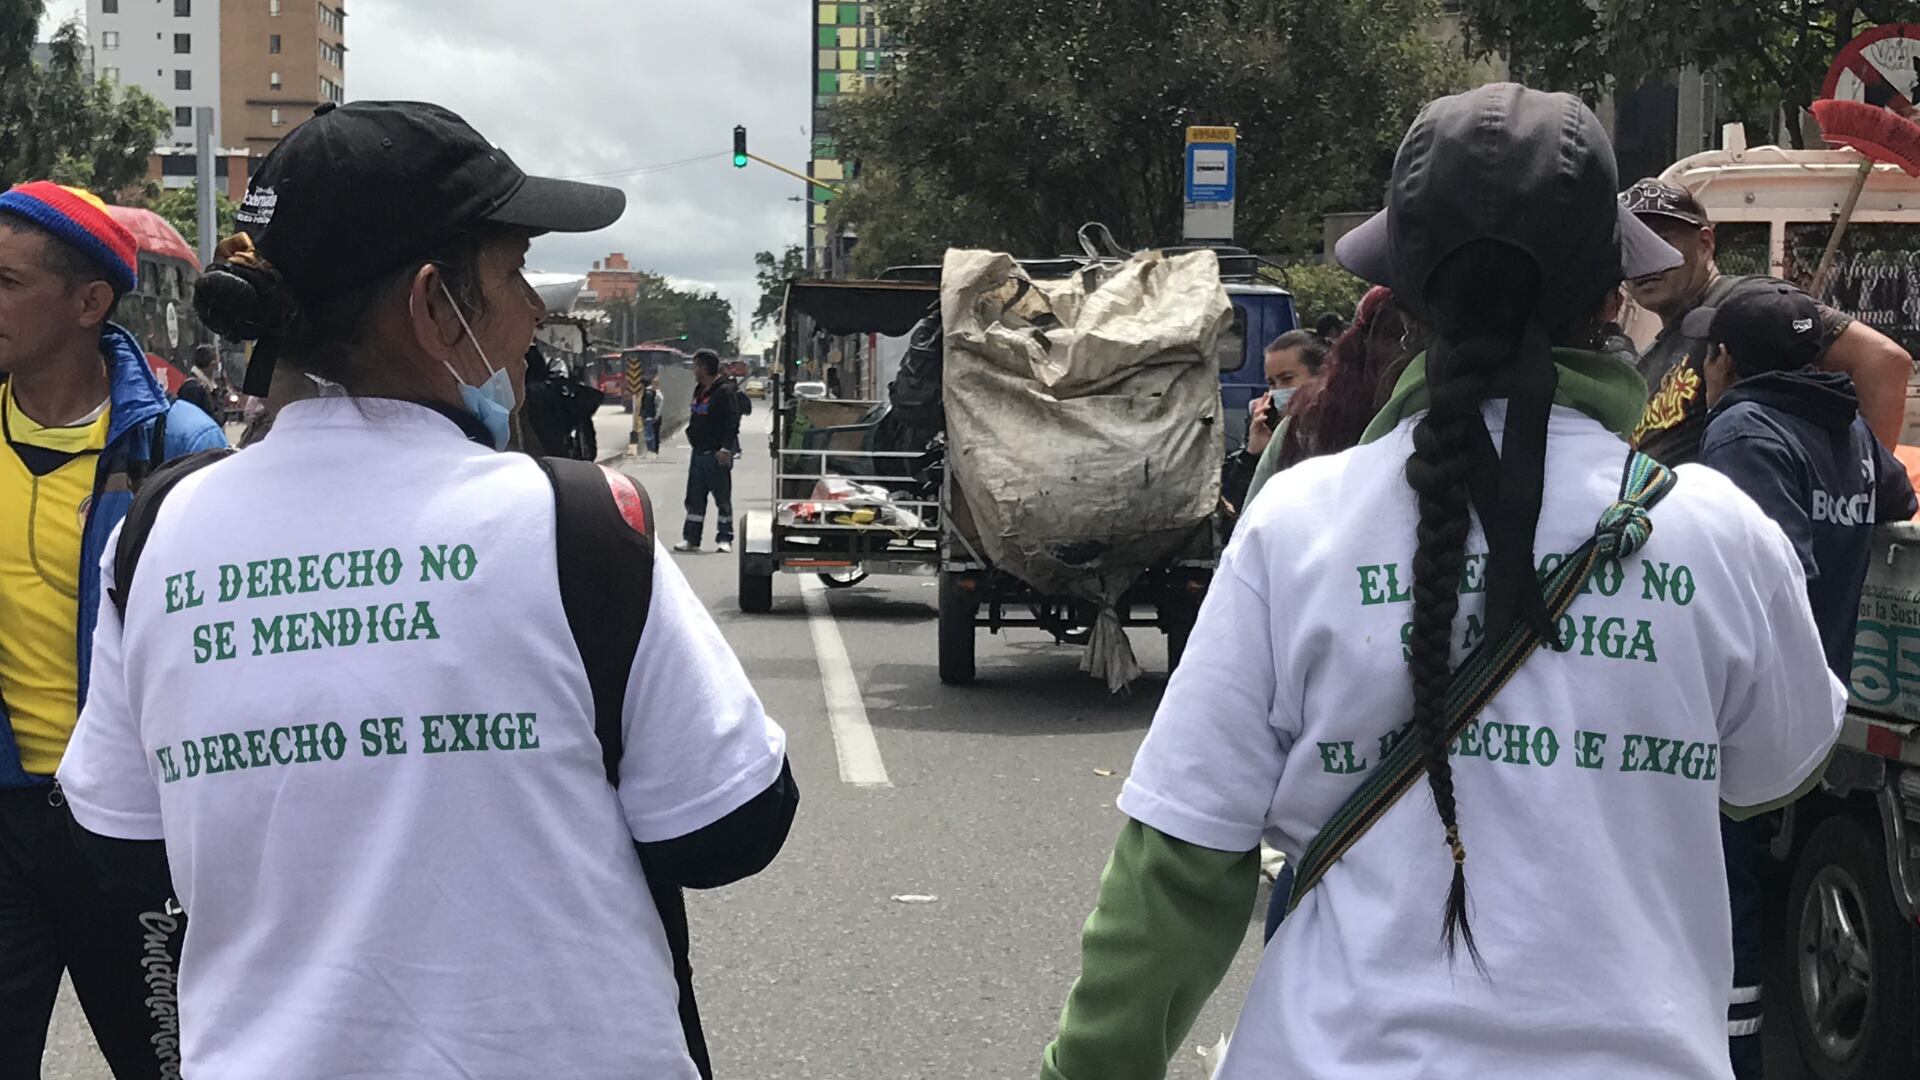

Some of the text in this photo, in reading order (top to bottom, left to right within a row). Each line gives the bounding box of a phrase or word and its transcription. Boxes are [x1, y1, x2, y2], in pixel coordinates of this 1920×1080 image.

[165, 544, 478, 614] EL DERECHO NO
[1356, 563, 1411, 606] EL
[1641, 559, 1697, 606] NO
[193, 600, 441, 664] SE MENDIGA
[1875, 601, 1886, 620] la
[156, 712, 540, 783] EL DERECHO SE EXIGE
[1316, 741, 1367, 775] EL
[1619, 734, 1718, 781] EXIGE
